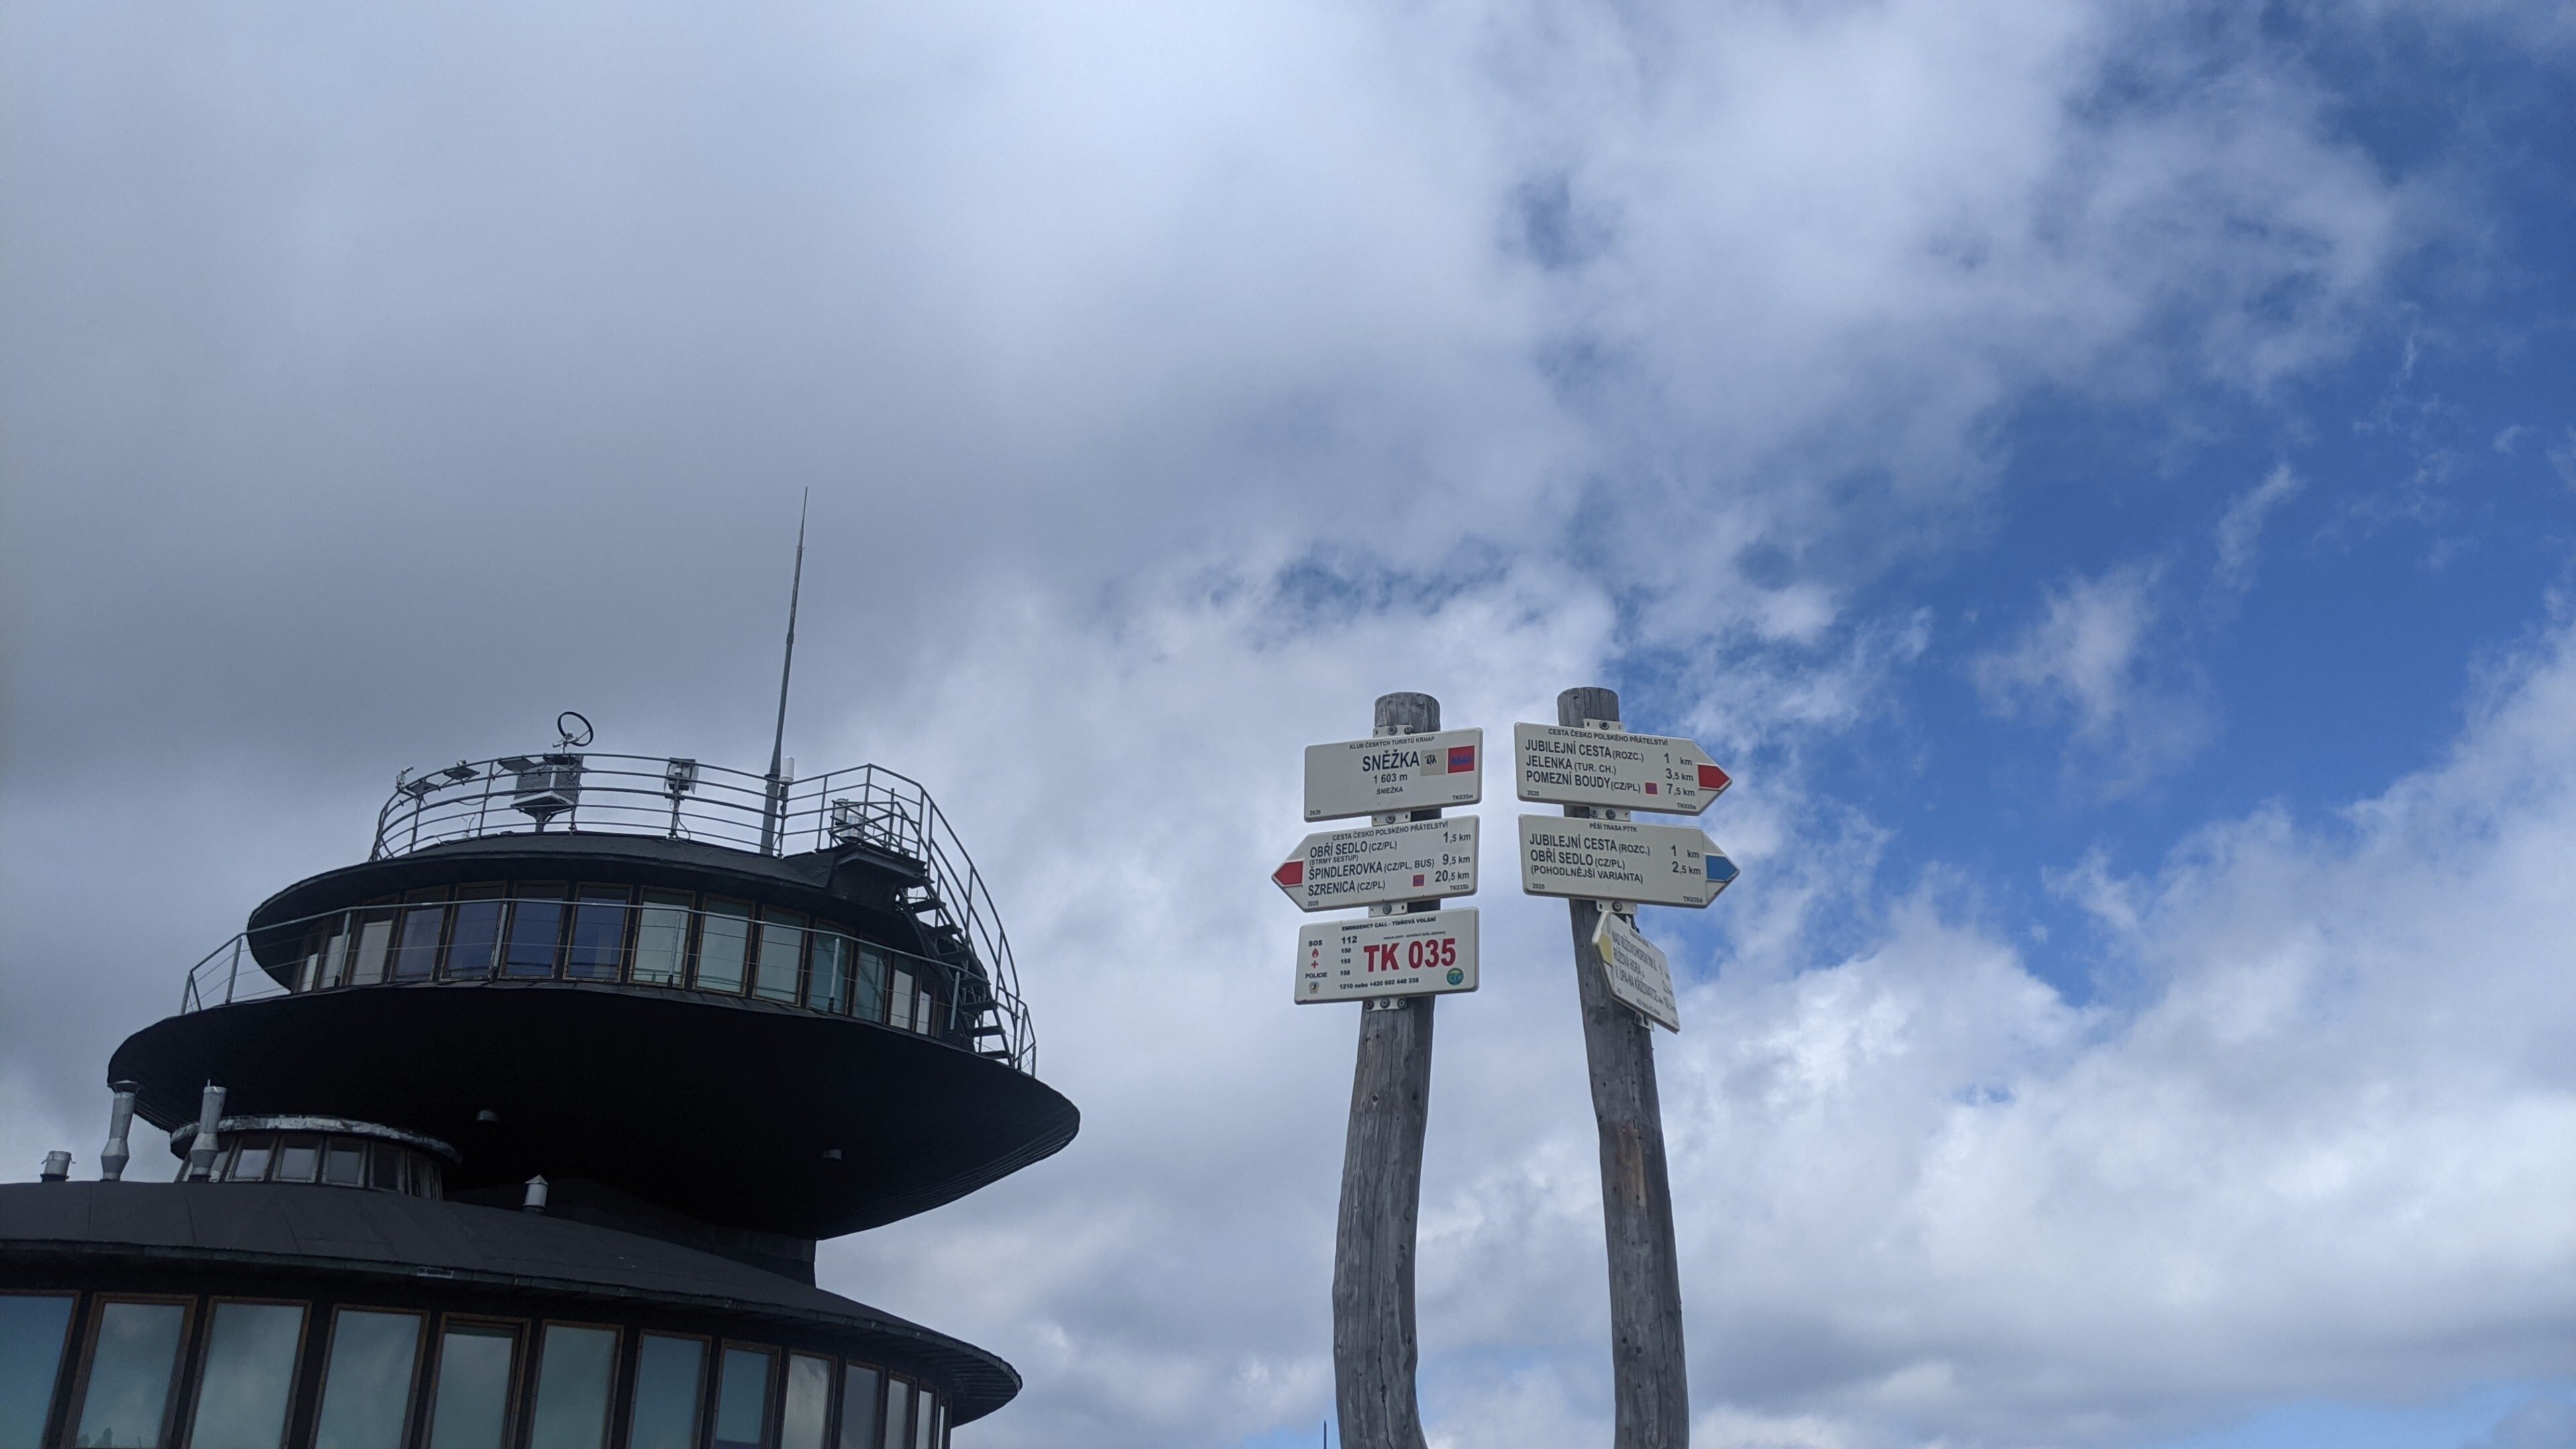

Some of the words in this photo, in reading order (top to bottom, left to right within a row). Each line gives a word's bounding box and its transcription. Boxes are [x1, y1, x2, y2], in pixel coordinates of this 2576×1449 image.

[1364, 739, 1391, 749] ČESKÝCH
[1392, 737, 1415, 746] TURISTŮ
[1415, 736, 1435, 744] KRNAP
[1548, 729, 1569, 737] CESTA
[1570, 729, 1593, 739] ČESKO
[1593, 732, 1628, 743] POLSKÉHO
[1629, 735, 1668, 746] PŘÁTELSTVÍ
[1362, 749, 1420, 772] SNĚŽKA
[1525, 739, 1576, 755] JUBILEJNÍ
[1578, 744, 1612, 758] CESTA
[1613, 749, 1644, 763] (ROZC.)
[1664, 753, 1670, 764] 1
[1680, 757, 1693, 766] km
[1381, 773, 1397, 784] 603
[1526, 755, 1572, 770] JELENKA
[1574, 761, 1597, 773] (TUR.
[1599, 763, 1616, 775] CH.)
[1666, 768, 1680, 782] 3,5
[1681, 773, 1694, 782] km
[1526, 770, 1572, 786] POMEZNÍ
[1574, 774, 1610, 789] BOUDY
[1611, 780, 1641, 794] (CZ/PL)
[1666, 784, 1681, 797] 7,5
[1682, 788, 1695, 797] km
[1332, 832, 1352, 841] CESTA
[1353, 829, 1374, 839] ČESKO
[1375, 825, 1409, 837] POLSKÉHO
[1410, 820, 1448, 833] PŘÁTELSTVÍ
[1589, 822, 1602, 830] PĚŠÍ
[1603, 824, 1622, 832] TRASA
[1310, 842, 1334, 859] OBŘÍ
[1336, 840, 1368, 855] SEDLO
[1368, 840, 1397, 853] (CZ/PL)
[1443, 831, 1457, 844] 1,5
[1459, 833, 1471, 842] km
[1529, 833, 1581, 849] JUBILEJNÍ
[1584, 837, 1617, 853] CESTA
[1618, 843, 1650, 856] (ROZC.)
[1671, 845, 1677, 857] 1
[1687, 849, 1699, 859] km
[1309, 855, 1332, 867] (STRMÝ
[1333, 854, 1358, 864] SESTUP)
[1309, 861, 1383, 880] ŠPINDLEROVKA
[1384, 861, 1413, 873] (CZ/PL,
[1414, 858, 1435, 869] BUS)
[1442, 853, 1456, 865] 9,5
[1458, 855, 1470, 864] km
[1530, 848, 1556, 863] OBŘÍ
[1558, 851, 1593, 866] SEDLO
[1595, 856, 1625, 870] (CZ/PL)
[1672, 861, 1686, 874] 2,5
[1688, 867, 1701, 875] km
[1308, 880, 1356, 897] SZRENICA
[1356, 880, 1386, 893] (CZ/PL)
[1435, 869, 1456, 883] 20,5
[1457, 871, 1470, 880] km
[1531, 865, 1596, 879] (POHODLNĚJŠÍ
[1598, 871, 1643, 884] VARIANTA)
[1342, 923, 1373, 931] EMERGENCY
[1416, 916, 1436, 924] VOLÁNÍ
[1341, 936, 1357, 944] 112
[1363, 942, 1401, 973] TK
[1408, 938, 1456, 969] 035
